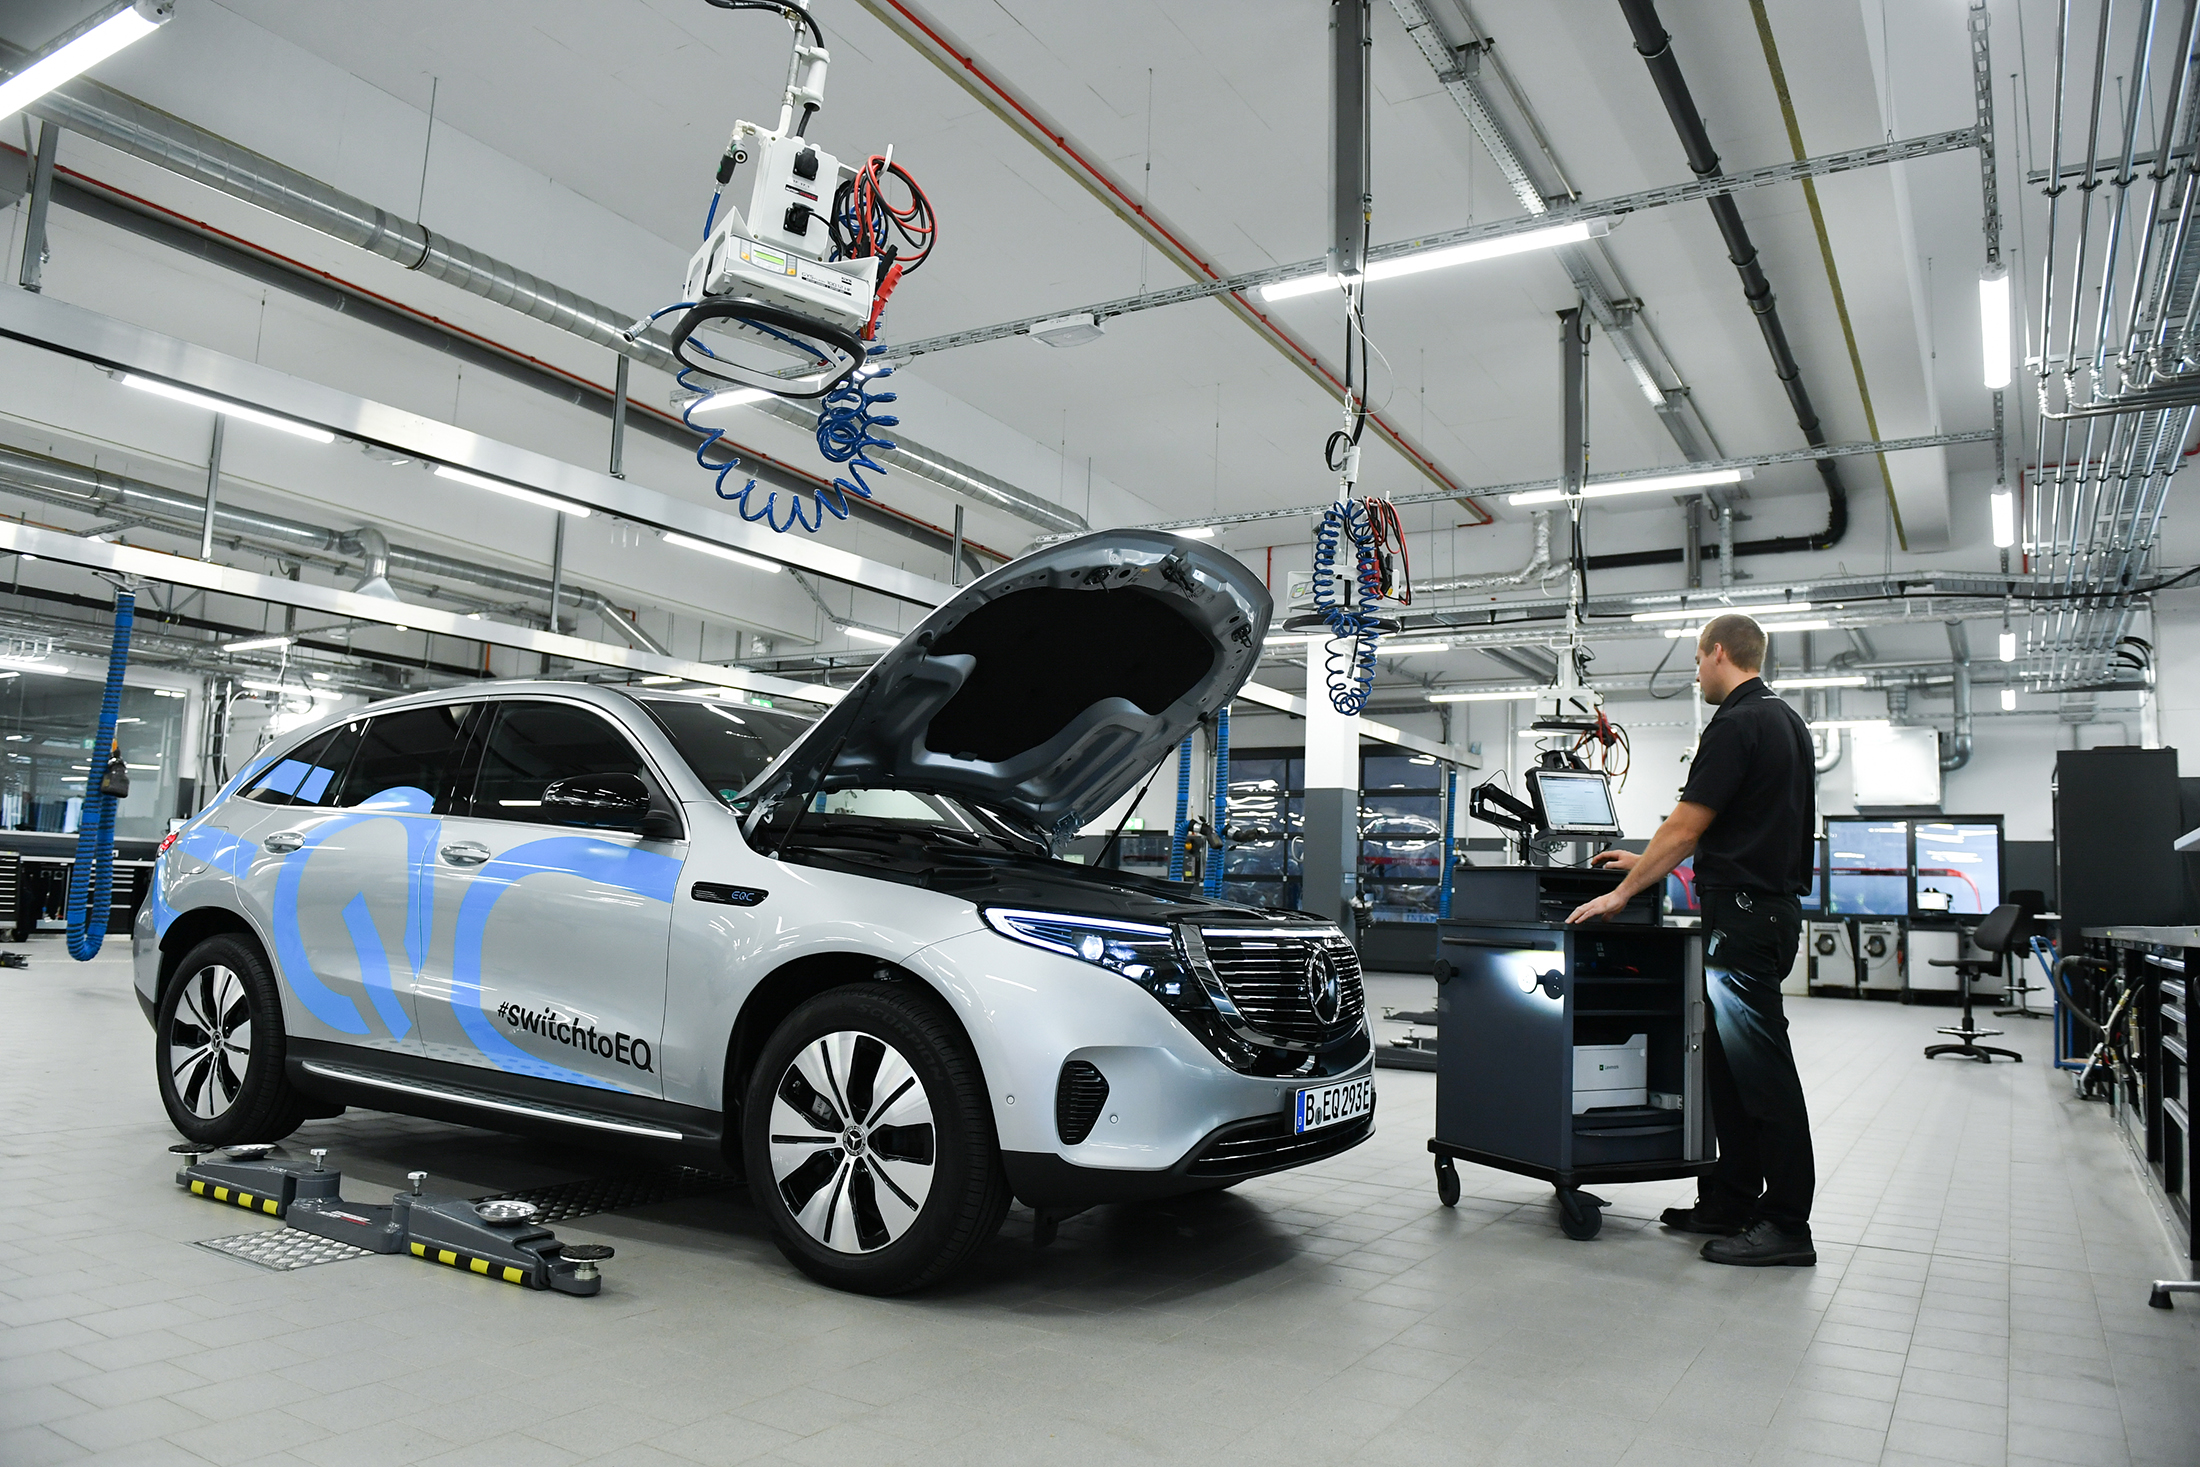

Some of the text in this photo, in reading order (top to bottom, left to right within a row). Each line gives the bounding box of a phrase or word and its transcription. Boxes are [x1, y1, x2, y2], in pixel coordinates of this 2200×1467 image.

[731, 890, 755, 902] EQC
[497, 1001, 654, 1073] #switchtoEQ
[1305, 1093, 1315, 1126] B
